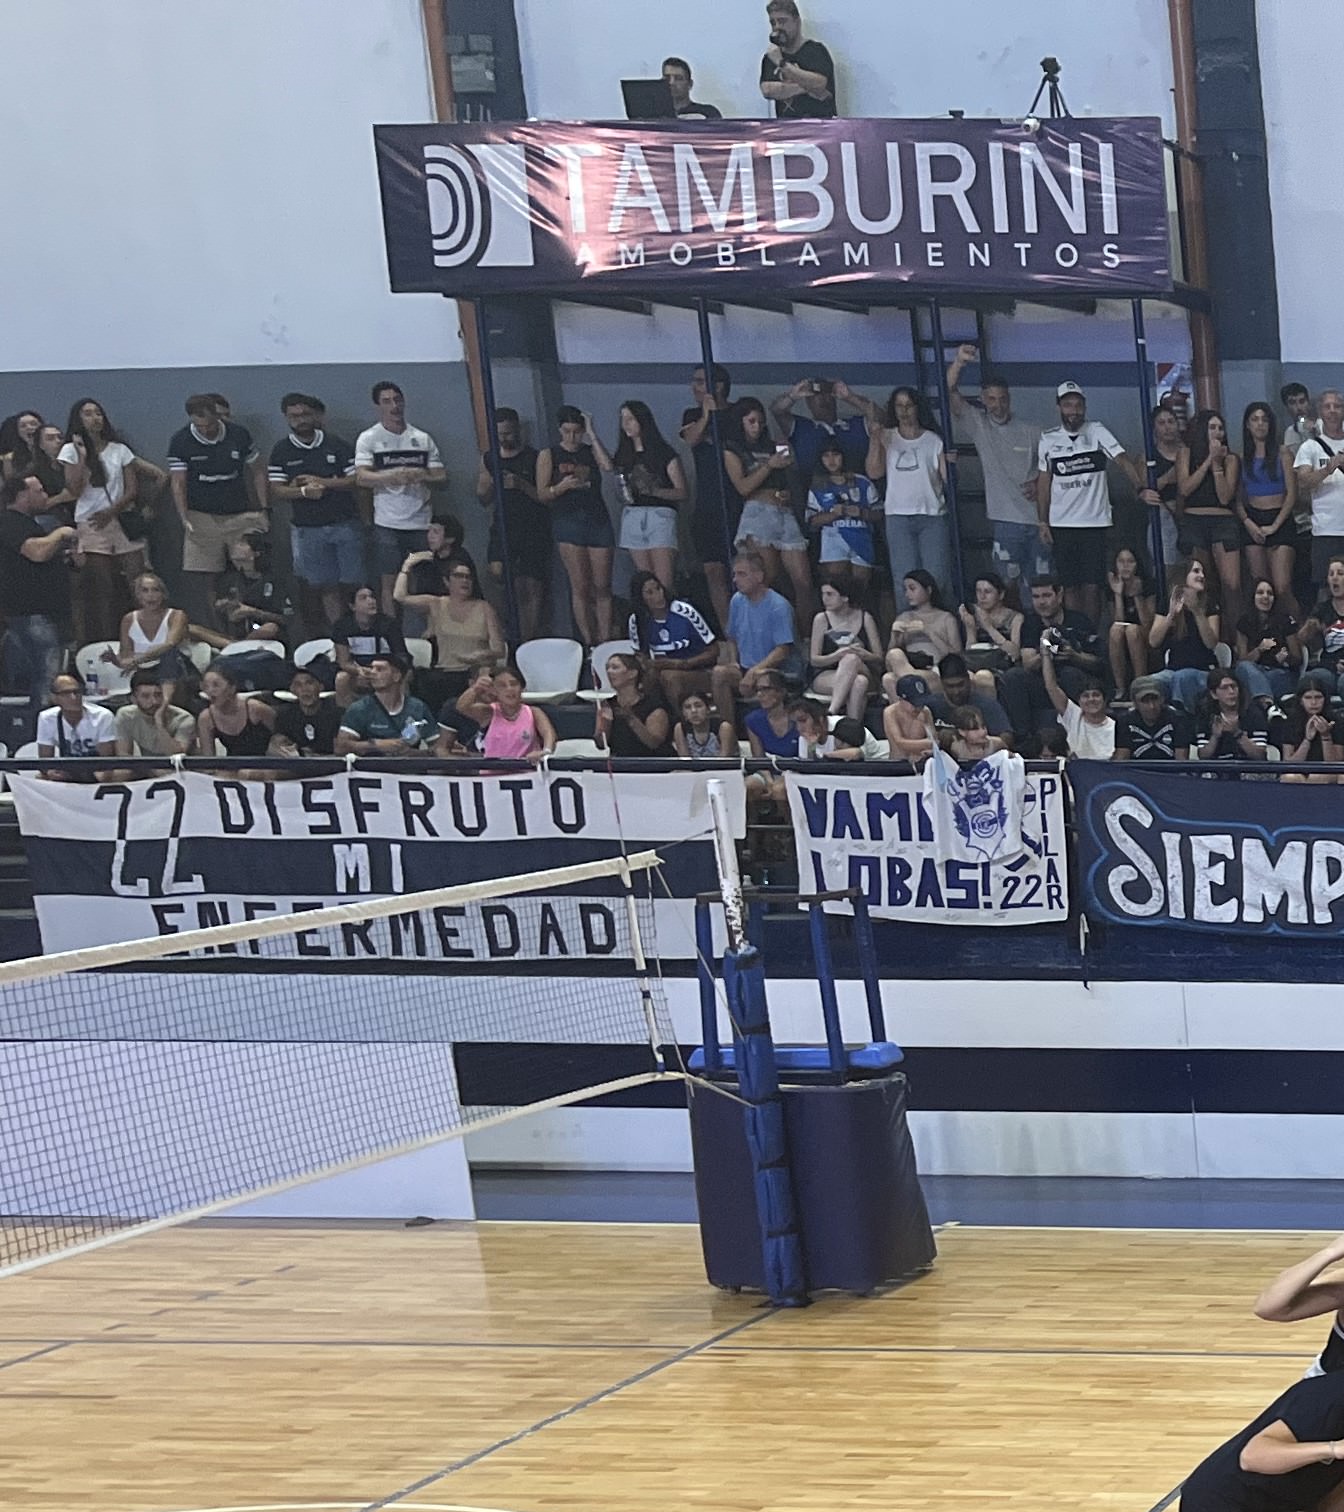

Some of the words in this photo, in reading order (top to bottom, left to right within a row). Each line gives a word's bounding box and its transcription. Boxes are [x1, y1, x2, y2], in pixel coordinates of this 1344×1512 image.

[542, 141, 1120, 237] TAMBURINI
[575, 240, 1122, 270] AMOBLAMIENTOS
[217, 776, 587, 838] DISFRUTO
[94, 781, 204, 897] 22
[333, 841, 405, 894] MI
[1039, 778, 1066, 910] PILAR
[1000, 875, 1044, 910] 22
